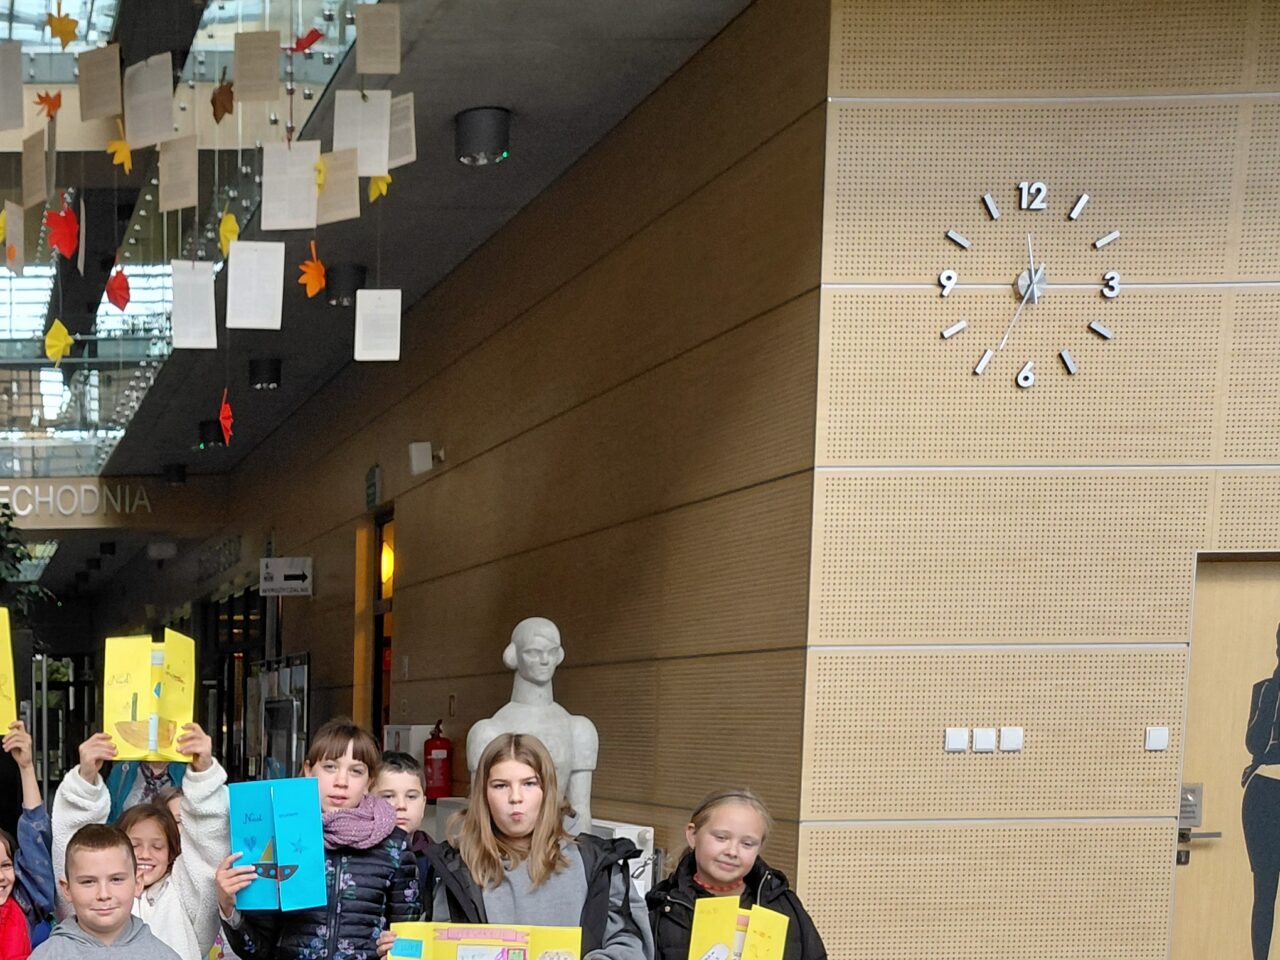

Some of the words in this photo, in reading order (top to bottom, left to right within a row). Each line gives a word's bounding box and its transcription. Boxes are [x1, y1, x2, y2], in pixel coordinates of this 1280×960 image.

[1018, 181, 1047, 210] 12
[939, 269, 958, 298] 9
[1101, 271, 1121, 298] 3
[1016, 360, 1035, 388] 6
